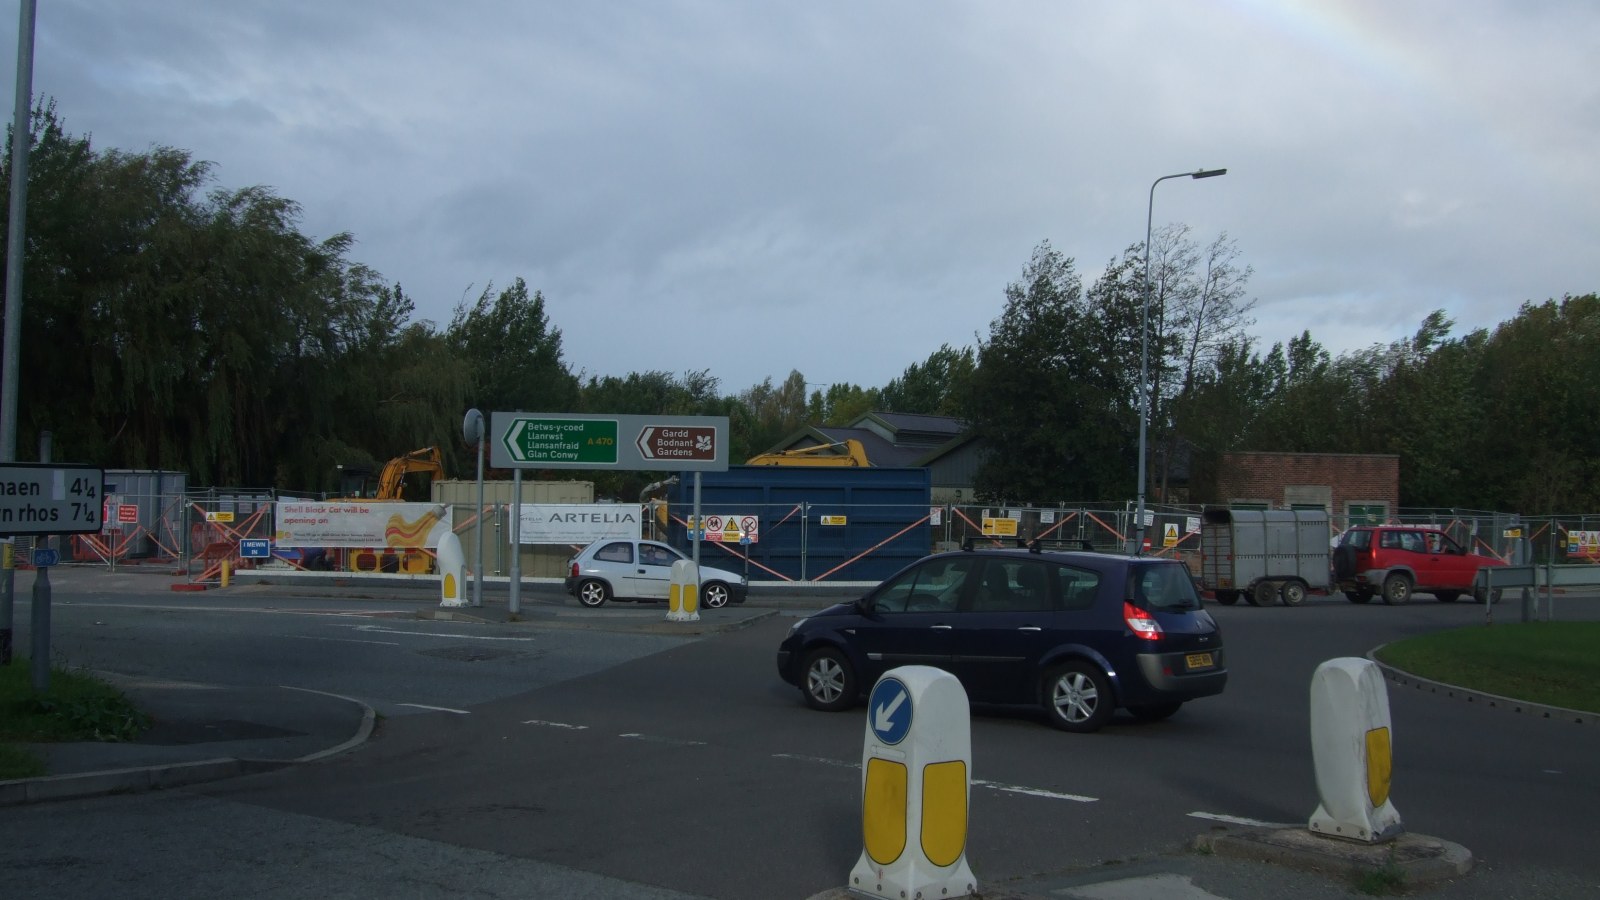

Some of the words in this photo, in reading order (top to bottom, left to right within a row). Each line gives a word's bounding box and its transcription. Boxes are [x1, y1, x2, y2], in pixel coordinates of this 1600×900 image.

[527, 422, 584, 432] Betws-y-coed
[527, 432, 564, 441] Llanrwst
[662, 429, 689, 438] Gardd
[527, 441, 579, 450] Llansanfraid
[587, 438, 594, 446] A
[595, 437, 613, 446] 470
[657, 438, 693, 447] Bodnant
[527, 450, 548, 459] Glan
[550, 450, 579, 460] Conwy
[657, 447, 693, 456] Gardens
[19, 503, 59, 522] rhos
[284, 506, 303, 514] Shell
[328, 506, 342, 514] Cat
[343, 506, 358, 514] will
[359, 506, 370, 514] be
[284, 517, 317, 526] opening
[548, 512, 636, 524] ARTELIA
